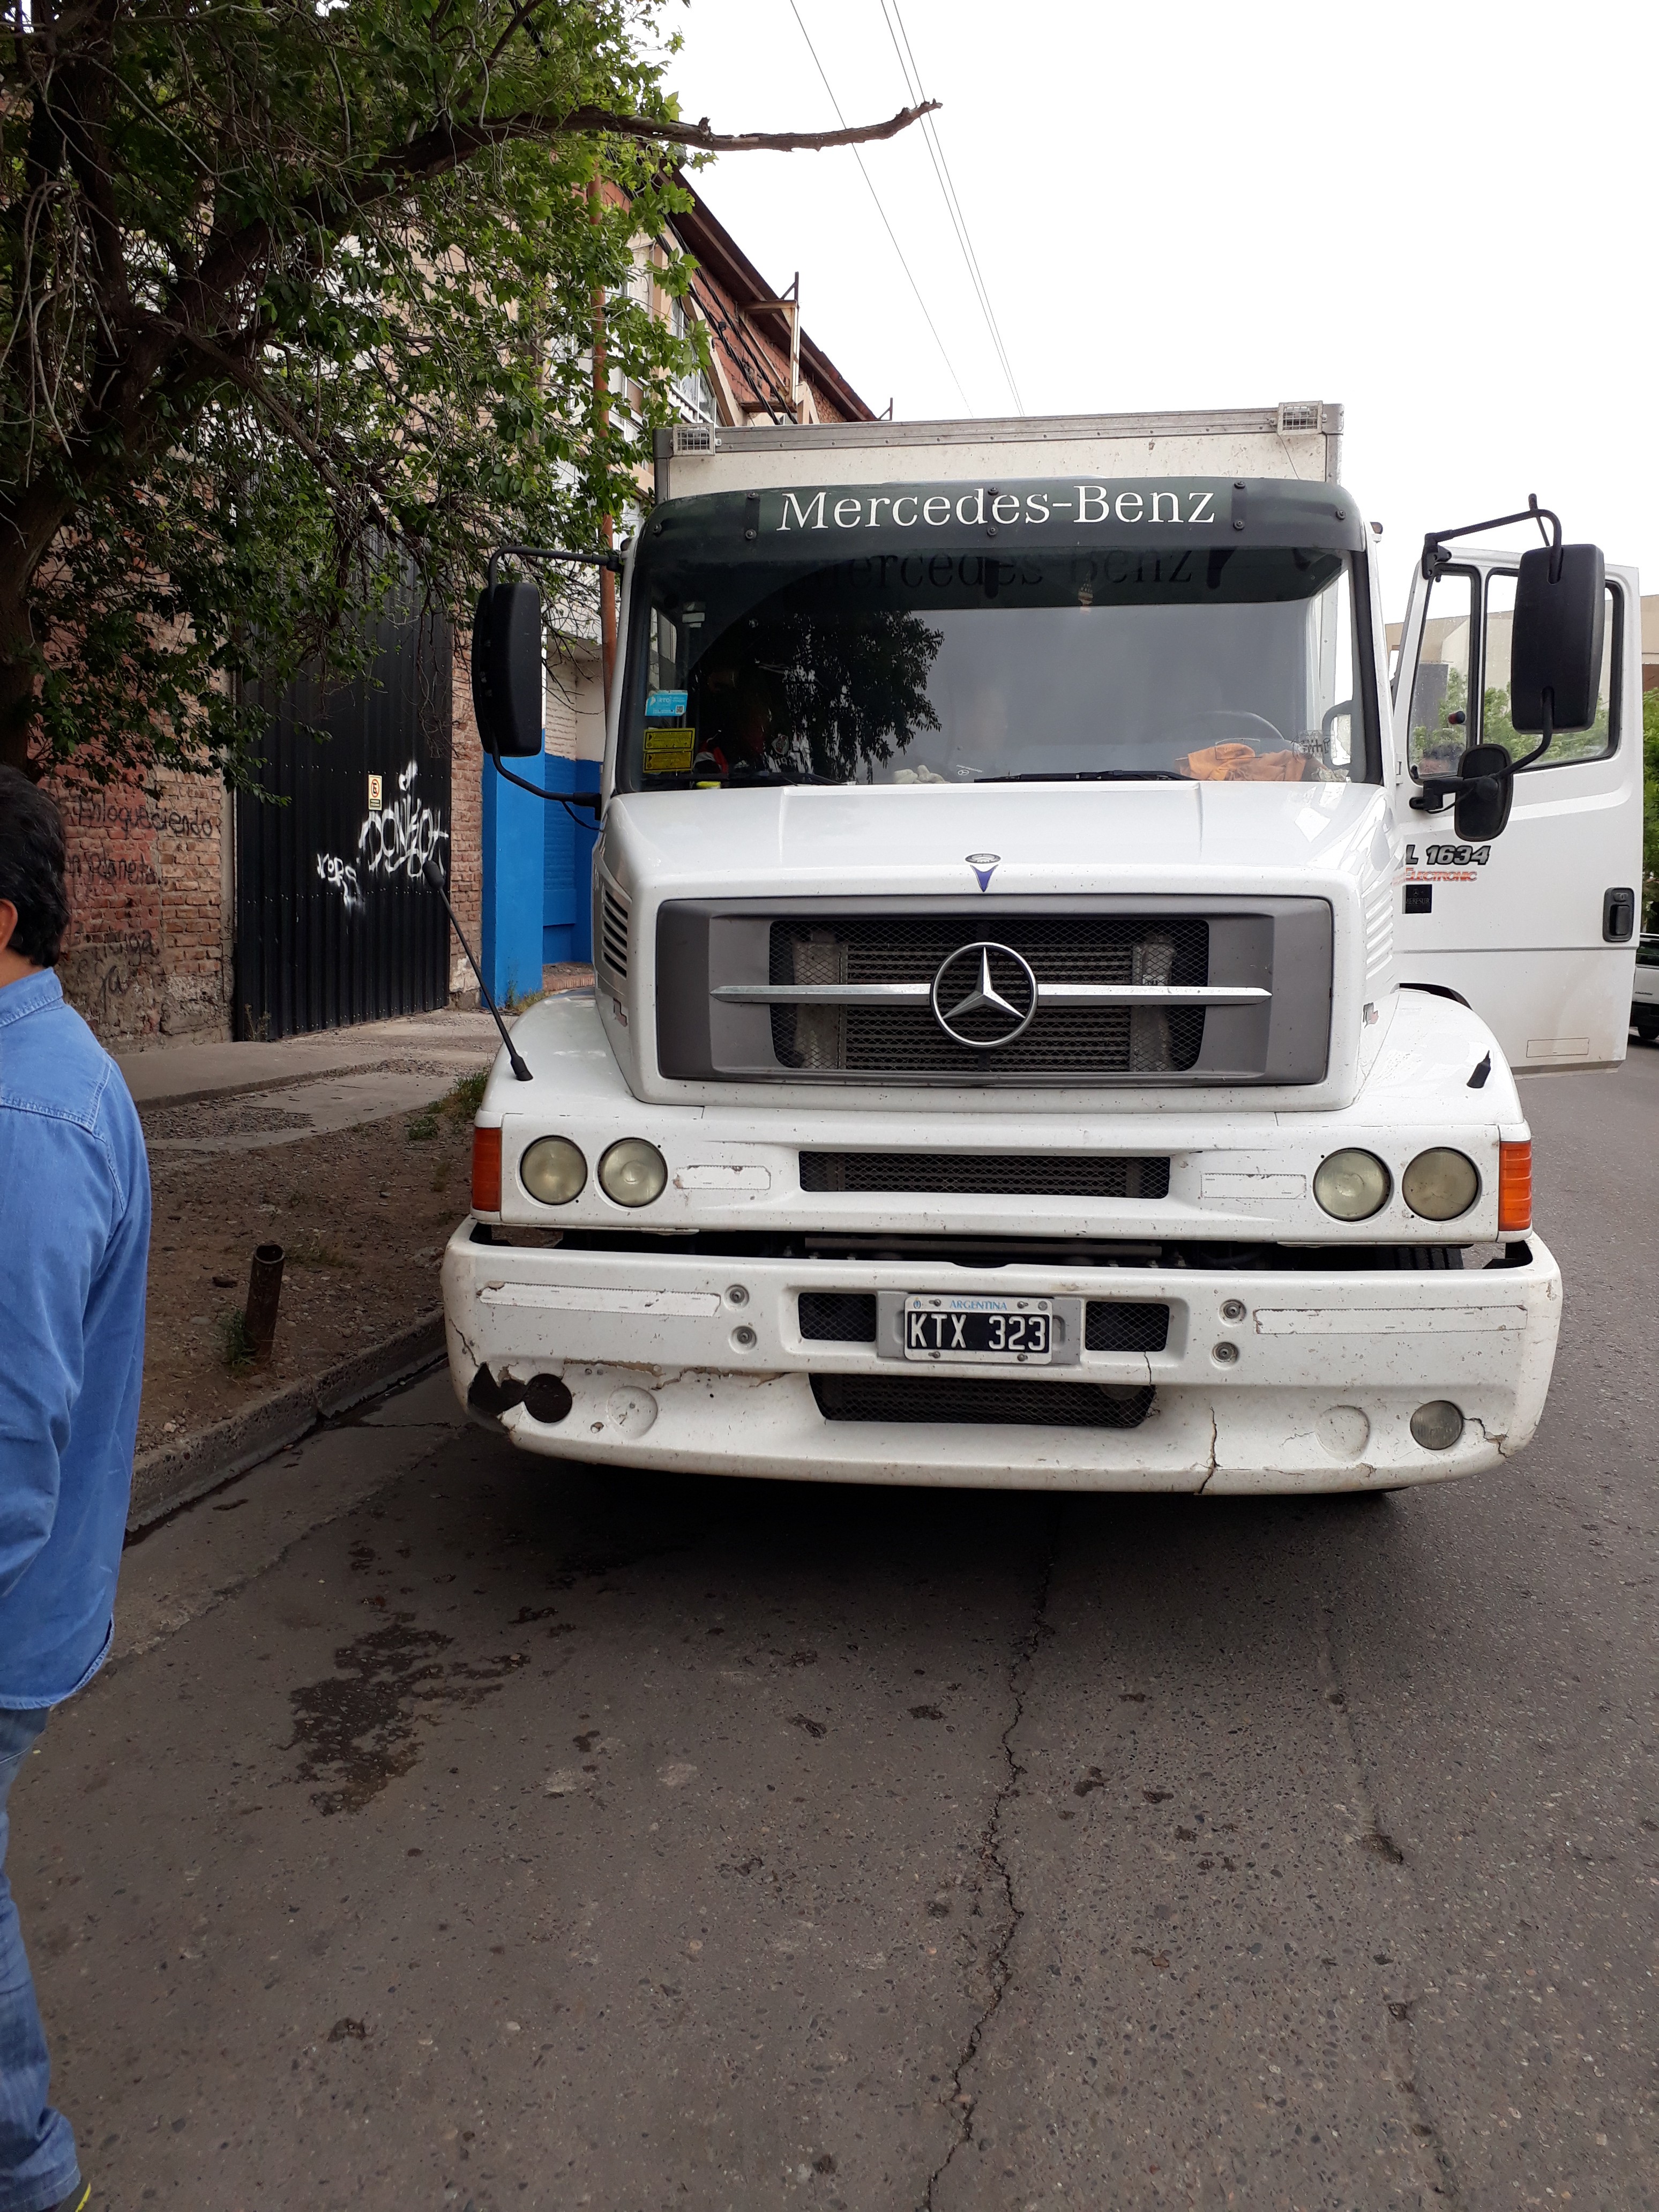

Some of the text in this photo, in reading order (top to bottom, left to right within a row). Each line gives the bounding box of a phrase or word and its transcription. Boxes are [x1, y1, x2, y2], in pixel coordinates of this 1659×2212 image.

[776, 484, 1216, 531] Mercedes-Benz
[1425, 844, 1492, 865] 1634
[949, 1299, 1007, 1311] ARGENTINA
[910, 1313, 1046, 1351] KTX 323
